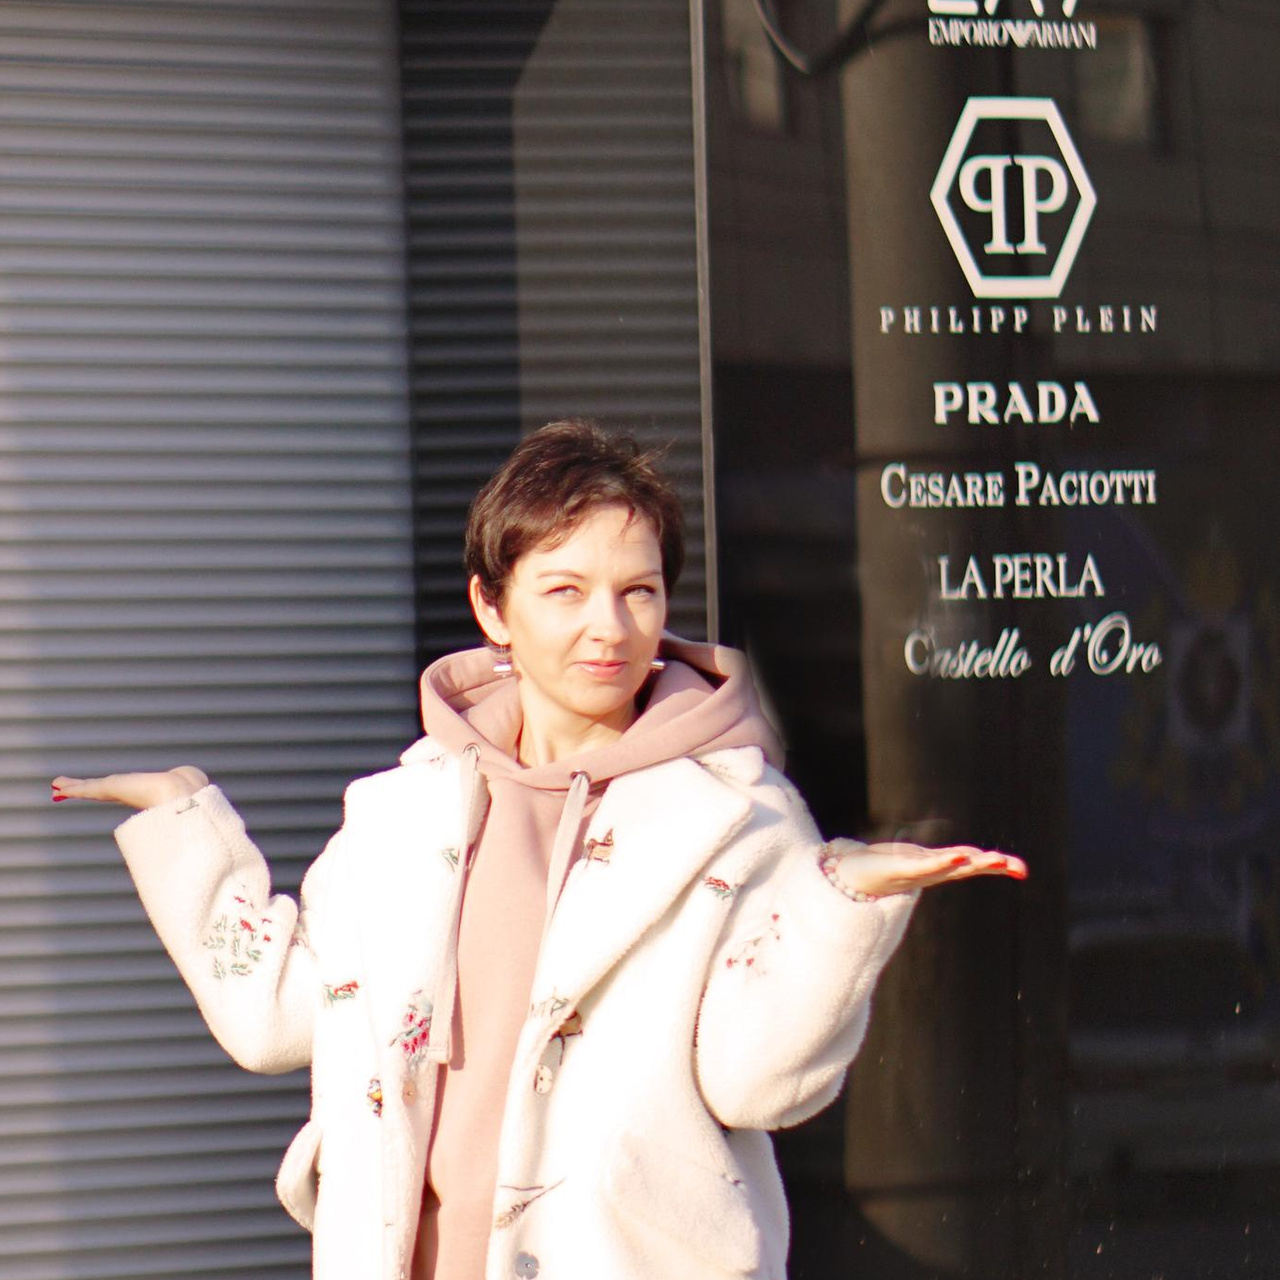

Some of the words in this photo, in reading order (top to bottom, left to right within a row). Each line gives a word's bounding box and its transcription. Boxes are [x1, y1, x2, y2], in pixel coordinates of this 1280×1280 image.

[879, 306, 1029, 334] PHILIPP
[1053, 305, 1158, 333] PLEIN
[933, 381, 1100, 425] PRADA
[1049, 612, 1162, 677] d'Oro
